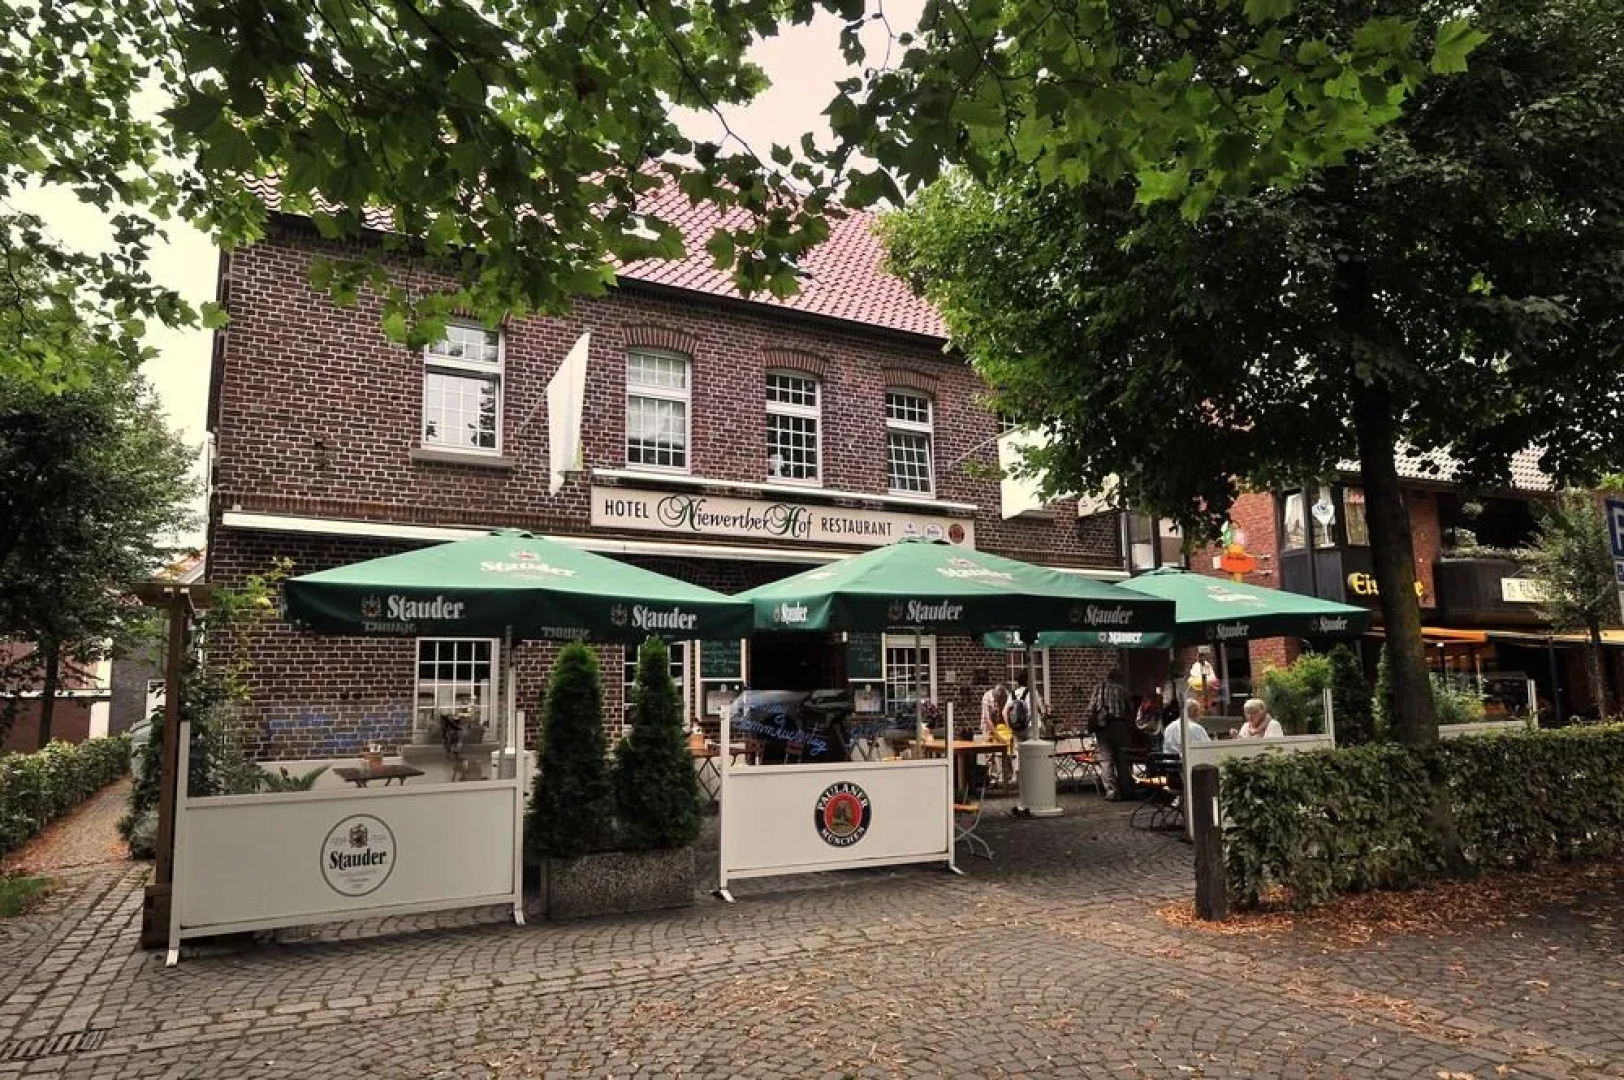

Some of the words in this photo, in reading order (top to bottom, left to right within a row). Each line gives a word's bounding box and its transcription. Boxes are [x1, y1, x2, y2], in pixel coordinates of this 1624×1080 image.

[605, 499, 649, 519] HOTEL
[657, 493, 768, 532] Niewerther
[764, 503, 813, 540] Hof
[821, 518, 892, 538] RESTAURANT
[480, 560, 577, 578] Stauder
[387, 594, 464, 621] Stauder
[632, 604, 697, 630] Stauder
[781, 601, 808, 624] Stauder
[907, 600, 963, 623] Stauder
[1084, 604, 1132, 626] Stauder
[1216, 621, 1249, 640] Stauder
[817, 784, 868, 810] PAULANER
[329, 847, 387, 871] Stauder
